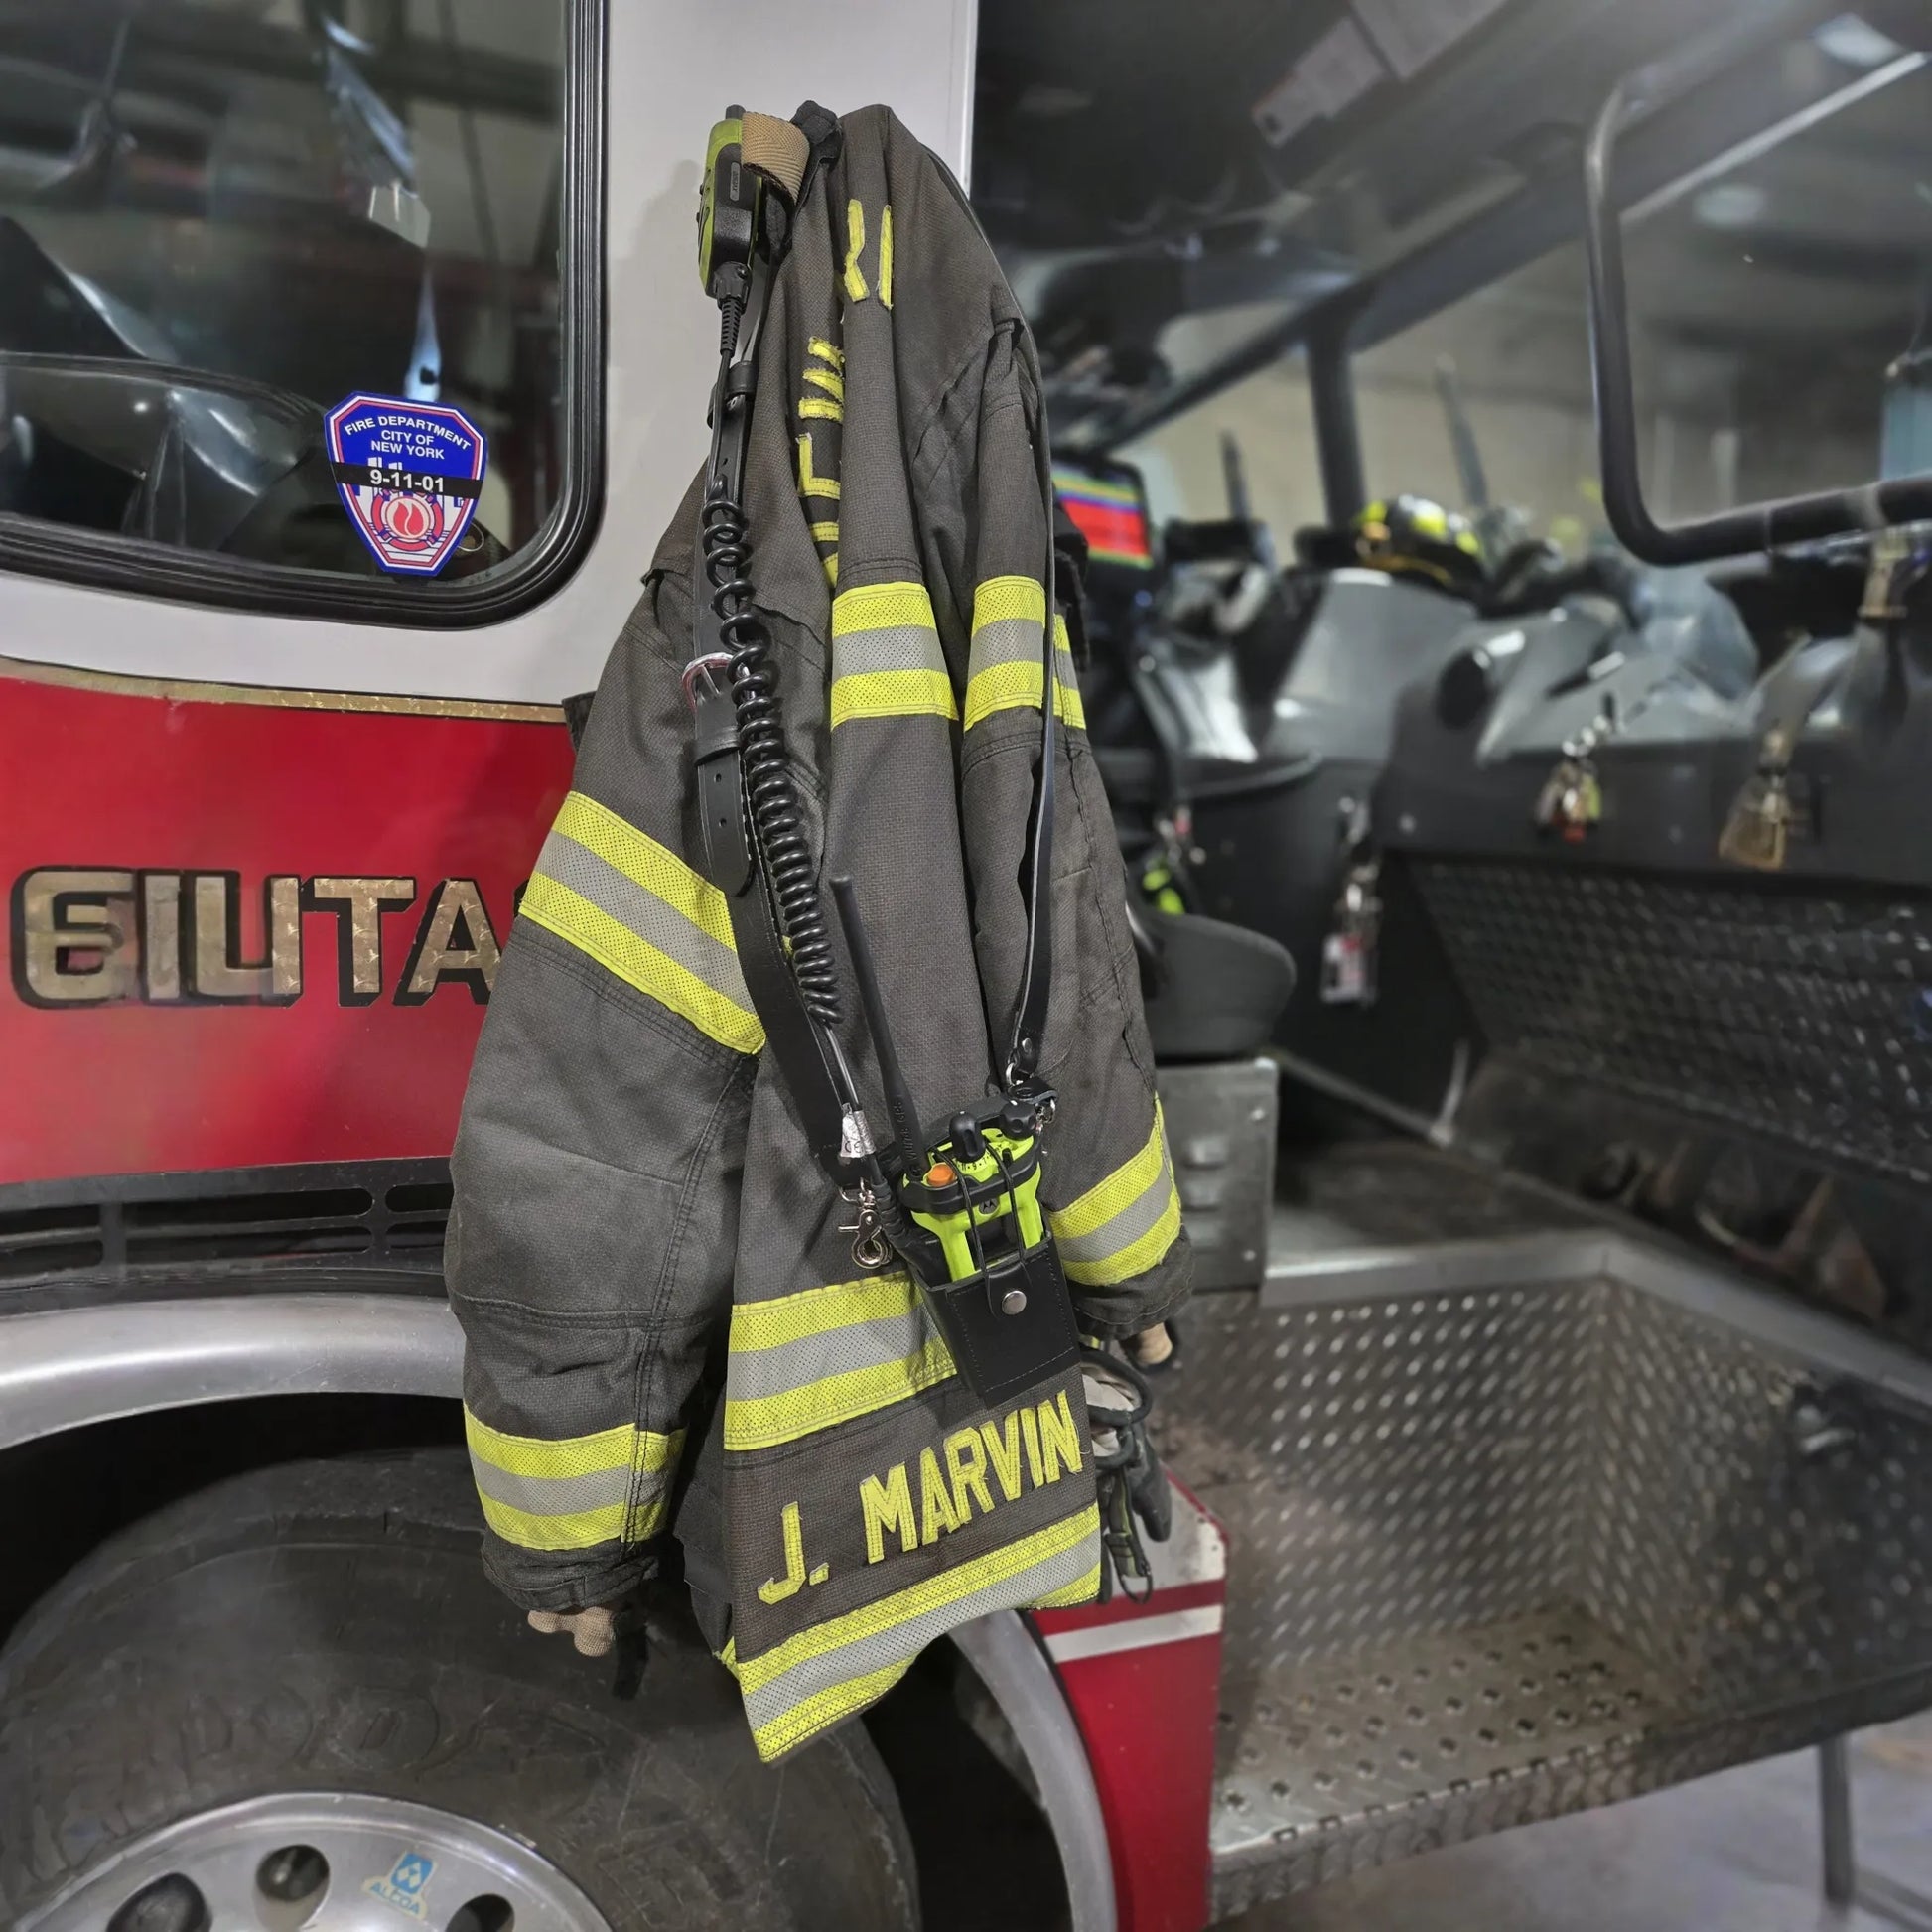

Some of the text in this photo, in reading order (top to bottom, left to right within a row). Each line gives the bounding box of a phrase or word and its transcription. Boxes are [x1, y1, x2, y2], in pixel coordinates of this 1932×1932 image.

[345, 415, 472, 450] FIRE DEPARTMENT
[381, 429, 435, 446] CITY OF
[370, 440, 445, 460] NEW YORK
[369, 469, 445, 493] 9-11-01
[758, 1389, 1084, 1605] J. MARVIN
